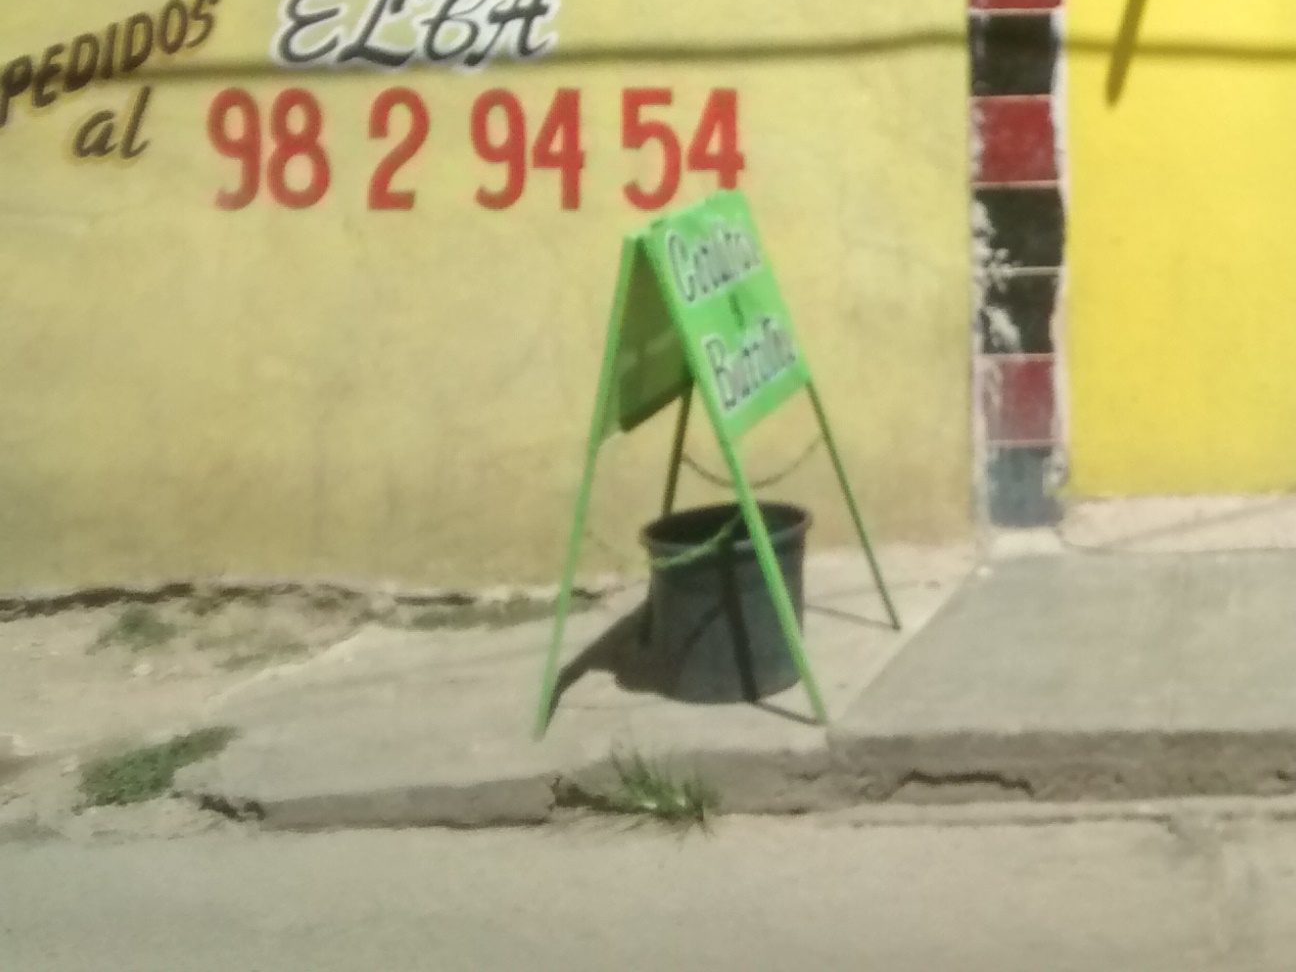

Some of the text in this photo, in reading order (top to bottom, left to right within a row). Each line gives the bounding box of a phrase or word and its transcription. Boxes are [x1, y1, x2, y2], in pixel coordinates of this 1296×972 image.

[69, 84, 745, 212] al 98 2 94 54
